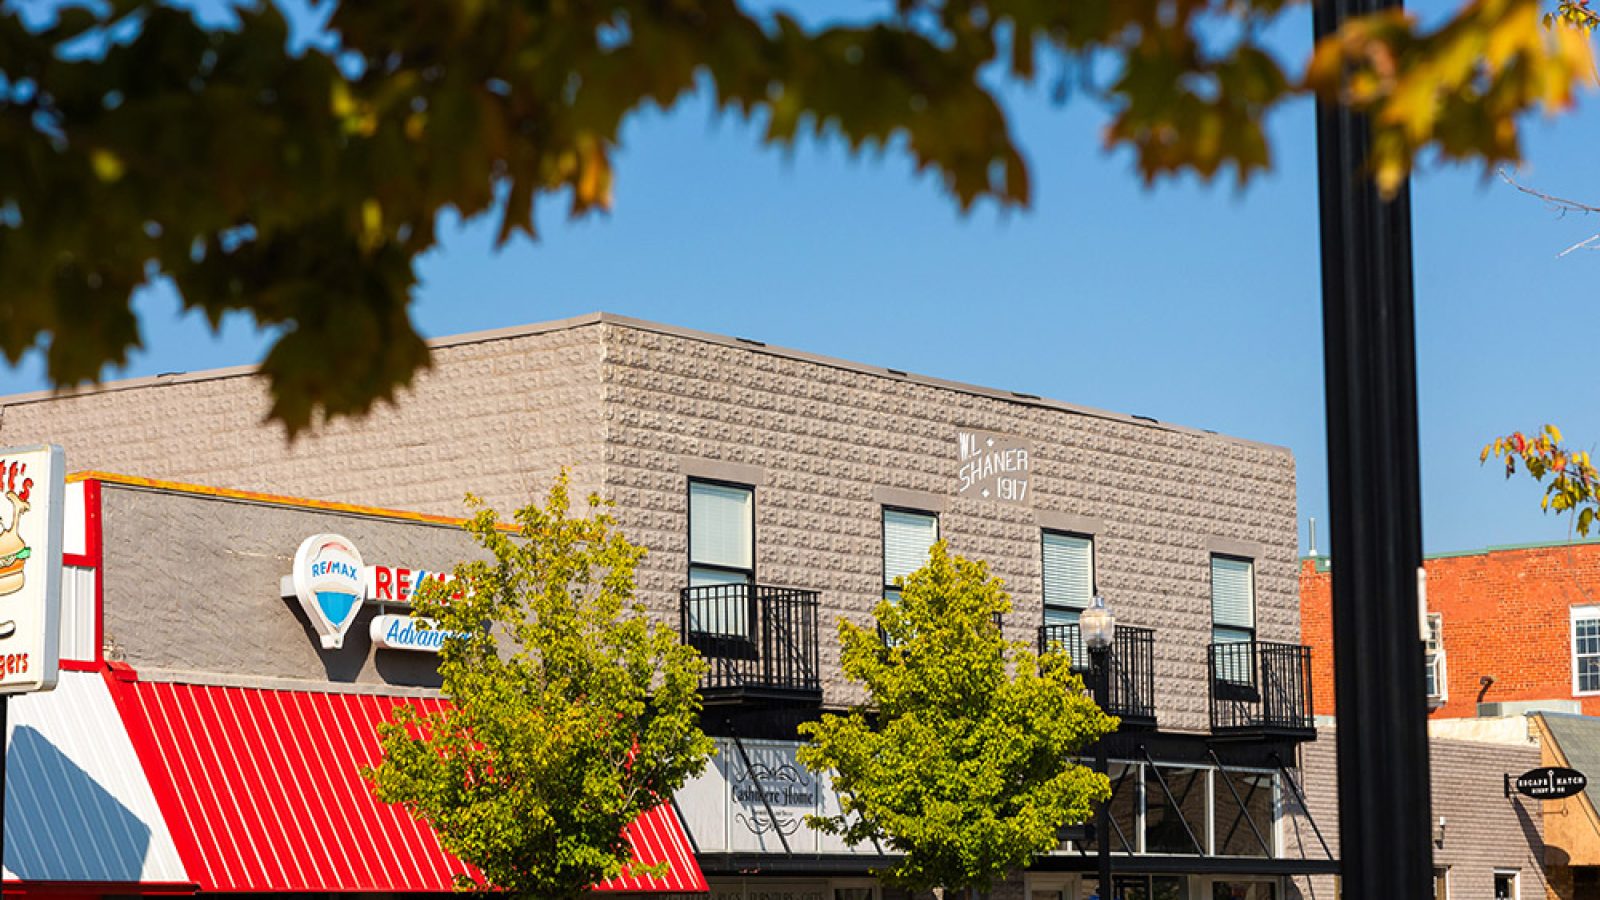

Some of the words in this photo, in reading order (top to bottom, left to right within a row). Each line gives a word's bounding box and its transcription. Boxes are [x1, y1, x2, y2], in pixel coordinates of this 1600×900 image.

[959, 450, 1028, 491] SHANER
[997, 477, 1028, 501] 1917
[311, 560, 358, 581] RE/MAX
[780, 784, 814, 806] Home
